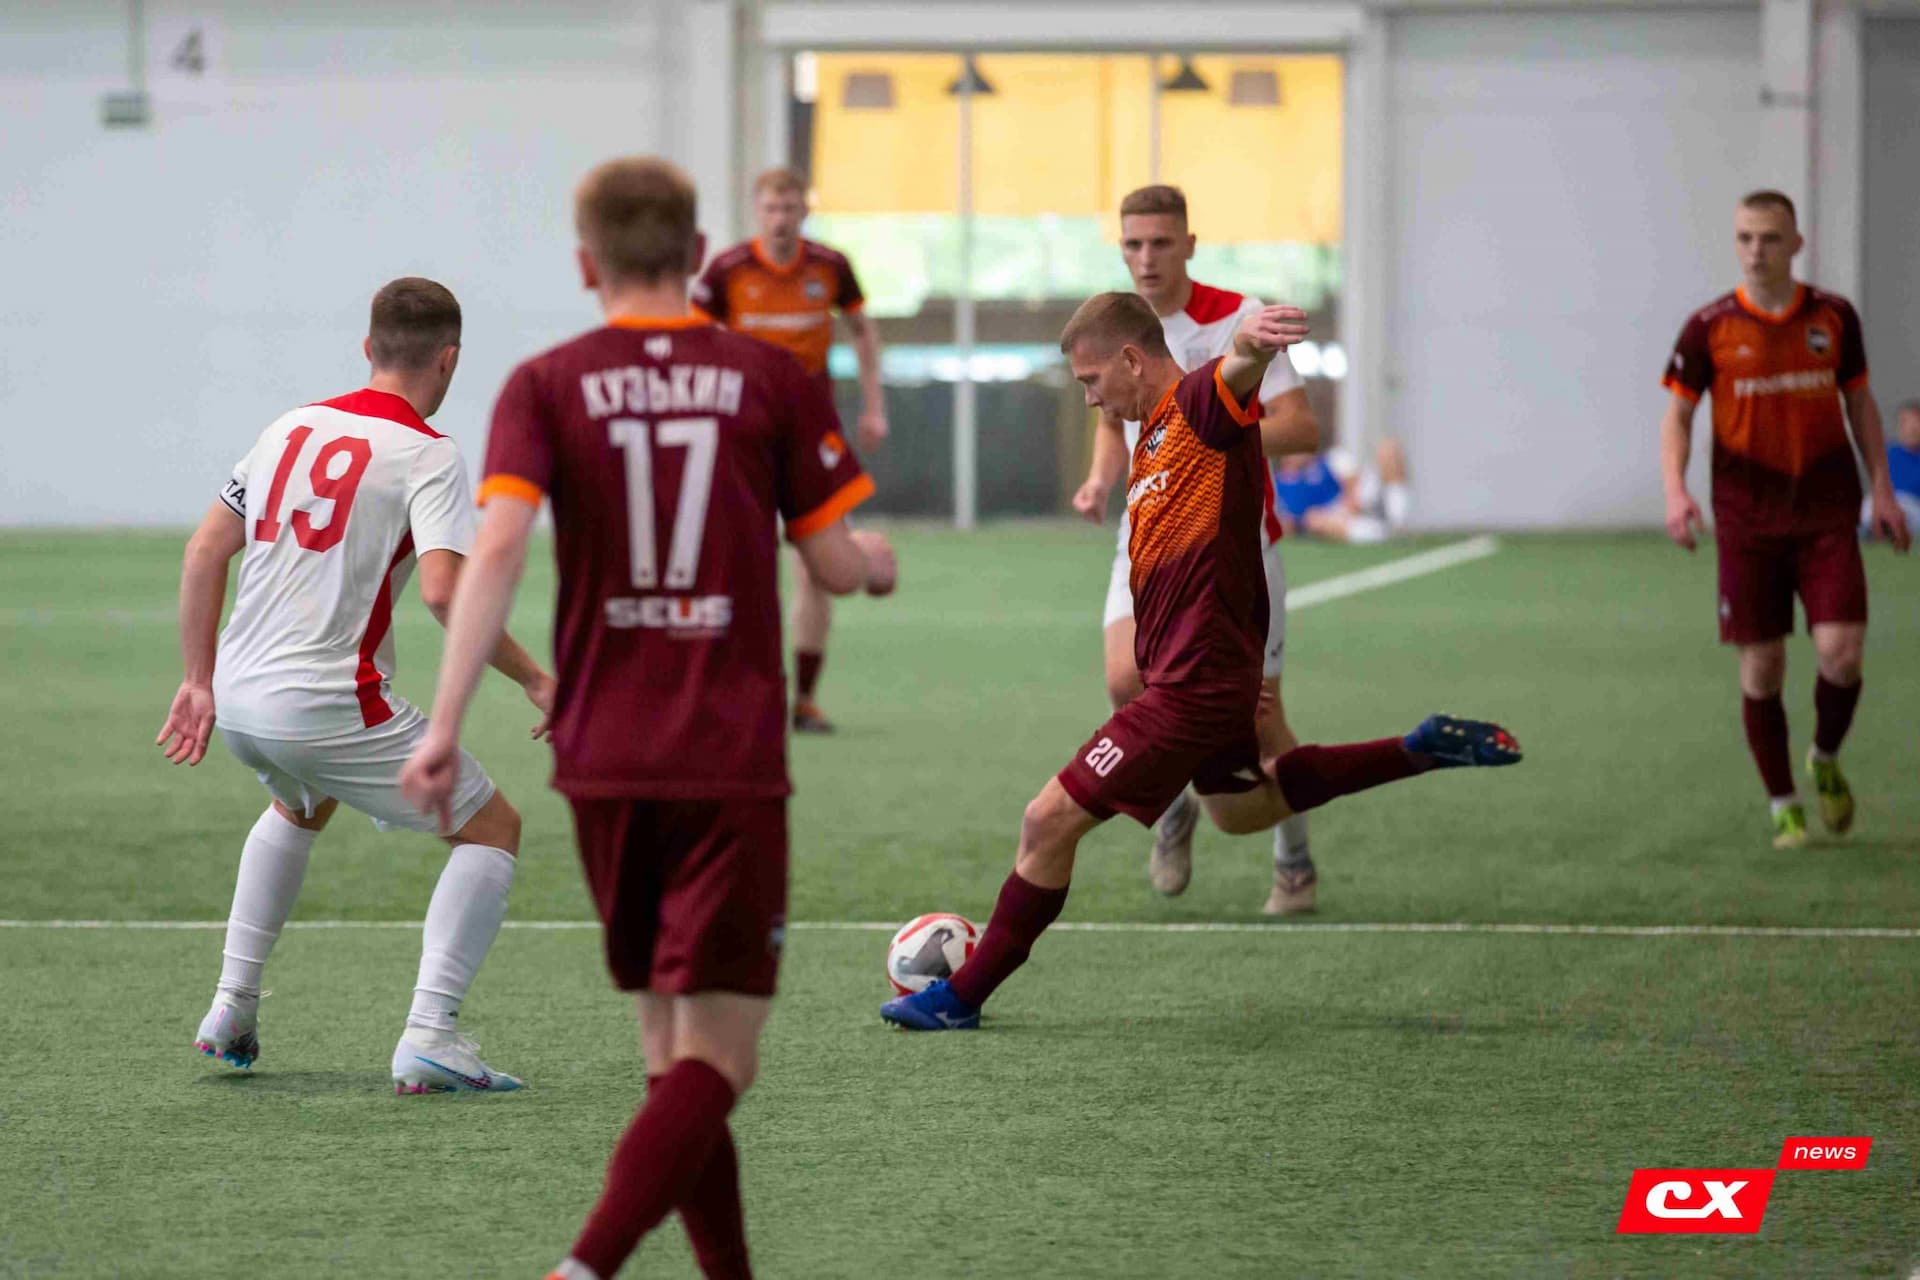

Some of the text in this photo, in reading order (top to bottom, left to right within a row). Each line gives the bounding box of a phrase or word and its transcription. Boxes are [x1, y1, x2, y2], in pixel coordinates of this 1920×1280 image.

[170, 30, 207, 78] 4
[581, 365, 743, 419] КУЗЬКИН
[255, 425, 372, 553] 19
[607, 418, 718, 588] 17
[1085, 737, 1124, 778] 20
